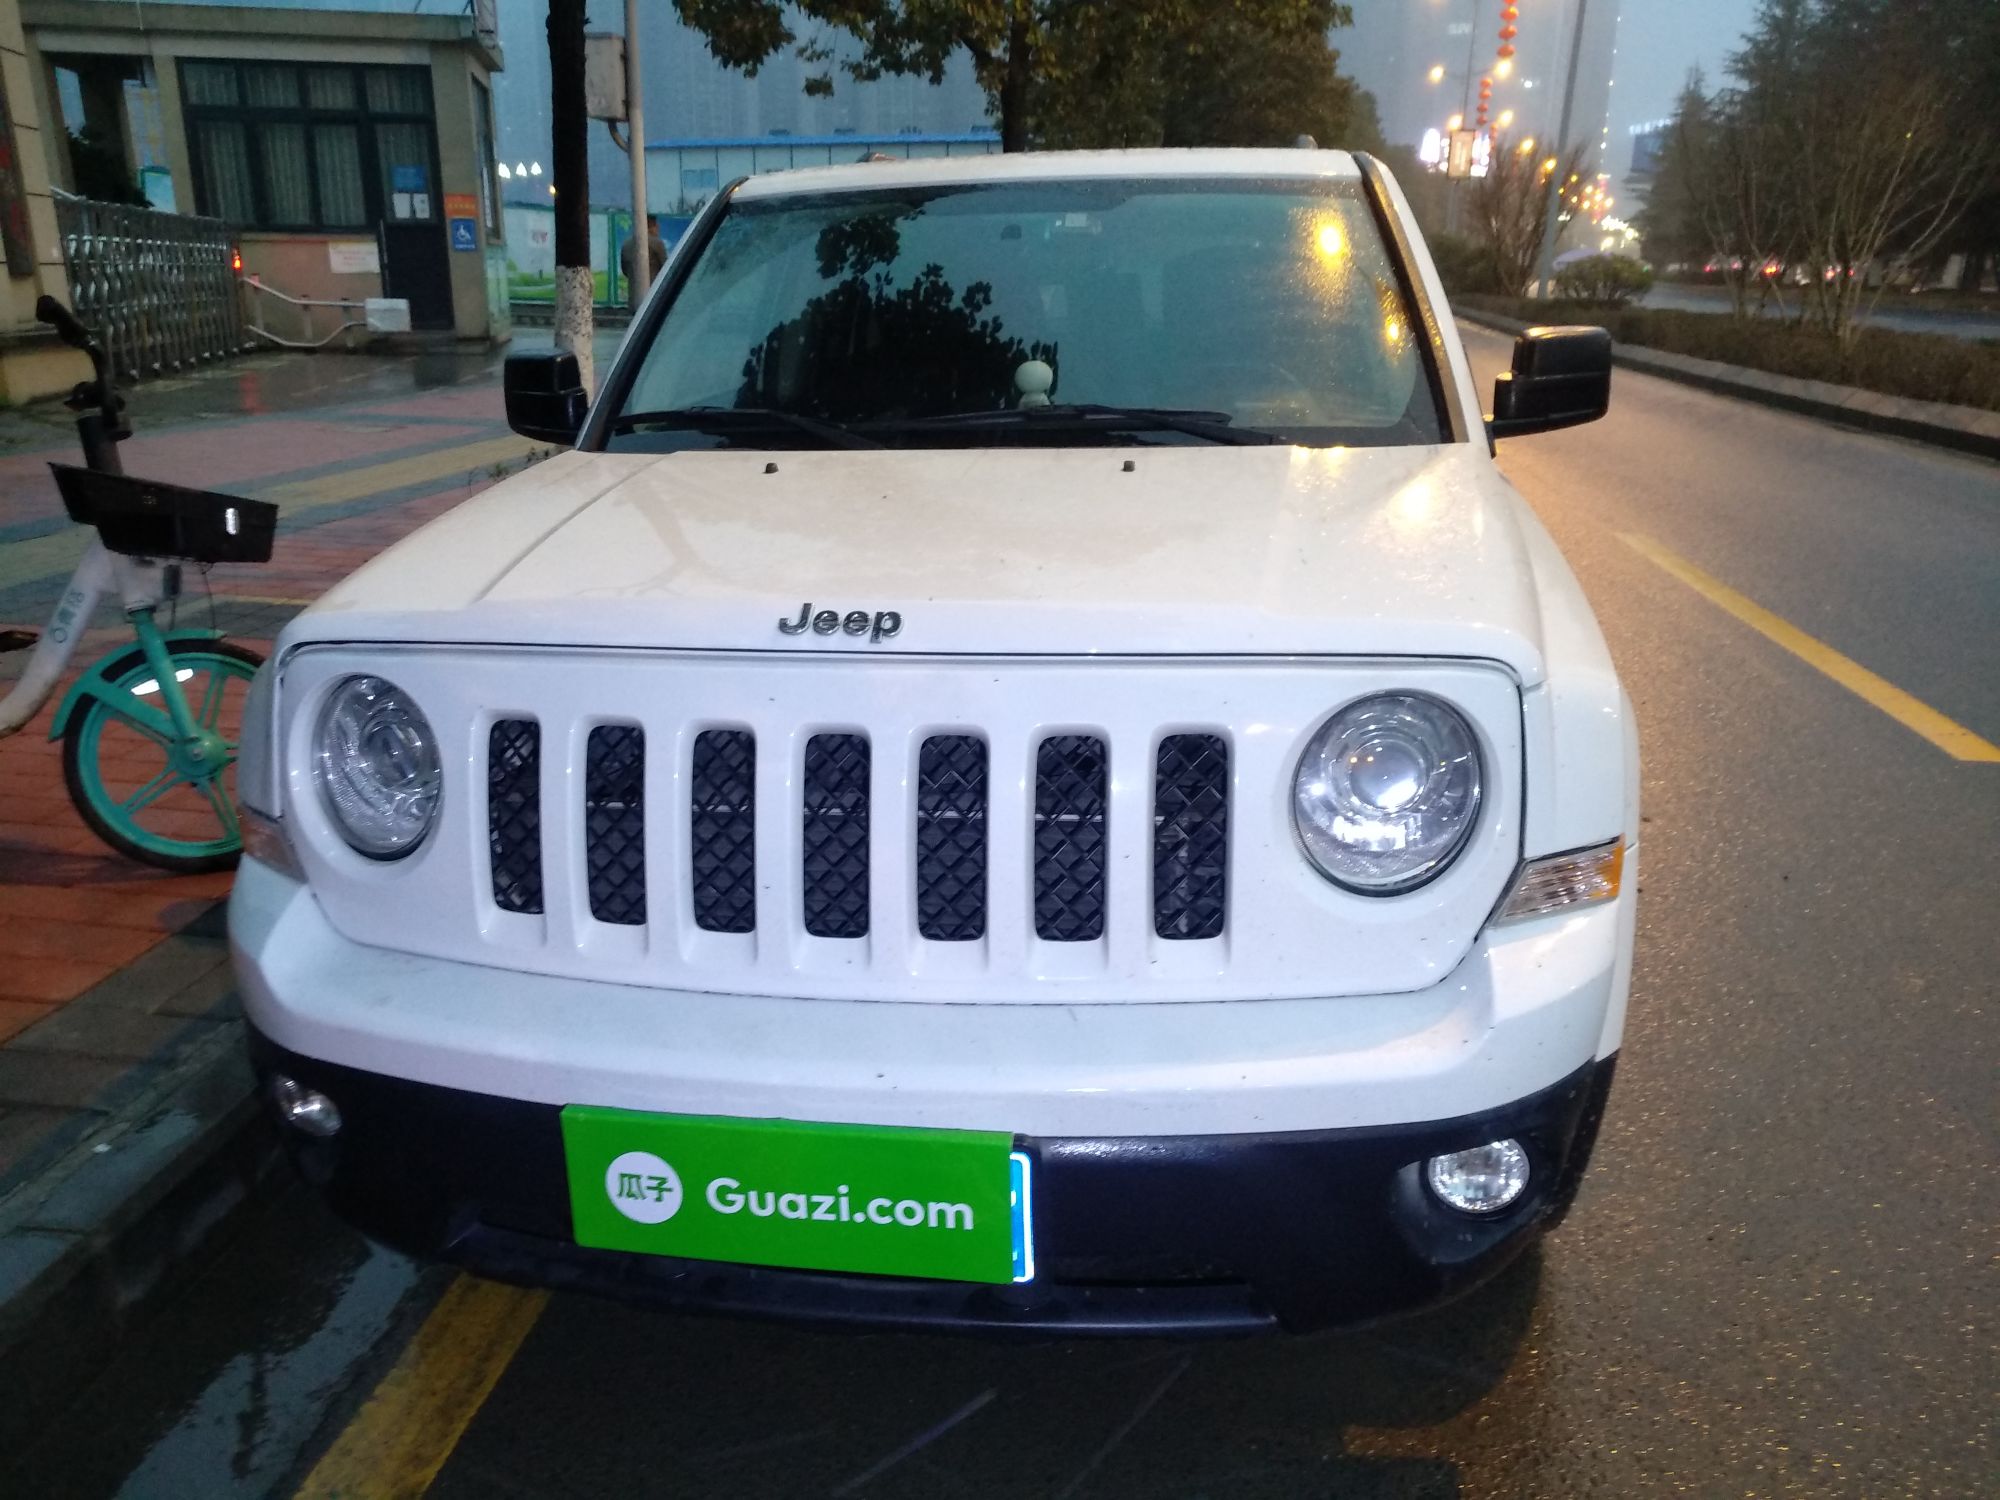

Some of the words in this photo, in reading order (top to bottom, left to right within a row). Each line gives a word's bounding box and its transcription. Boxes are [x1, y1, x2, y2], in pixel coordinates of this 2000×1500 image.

[778, 602, 902, 643] Jeep
[617, 1172, 674, 1202] 瓜子
[706, 1177, 974, 1230] Guazi.com
